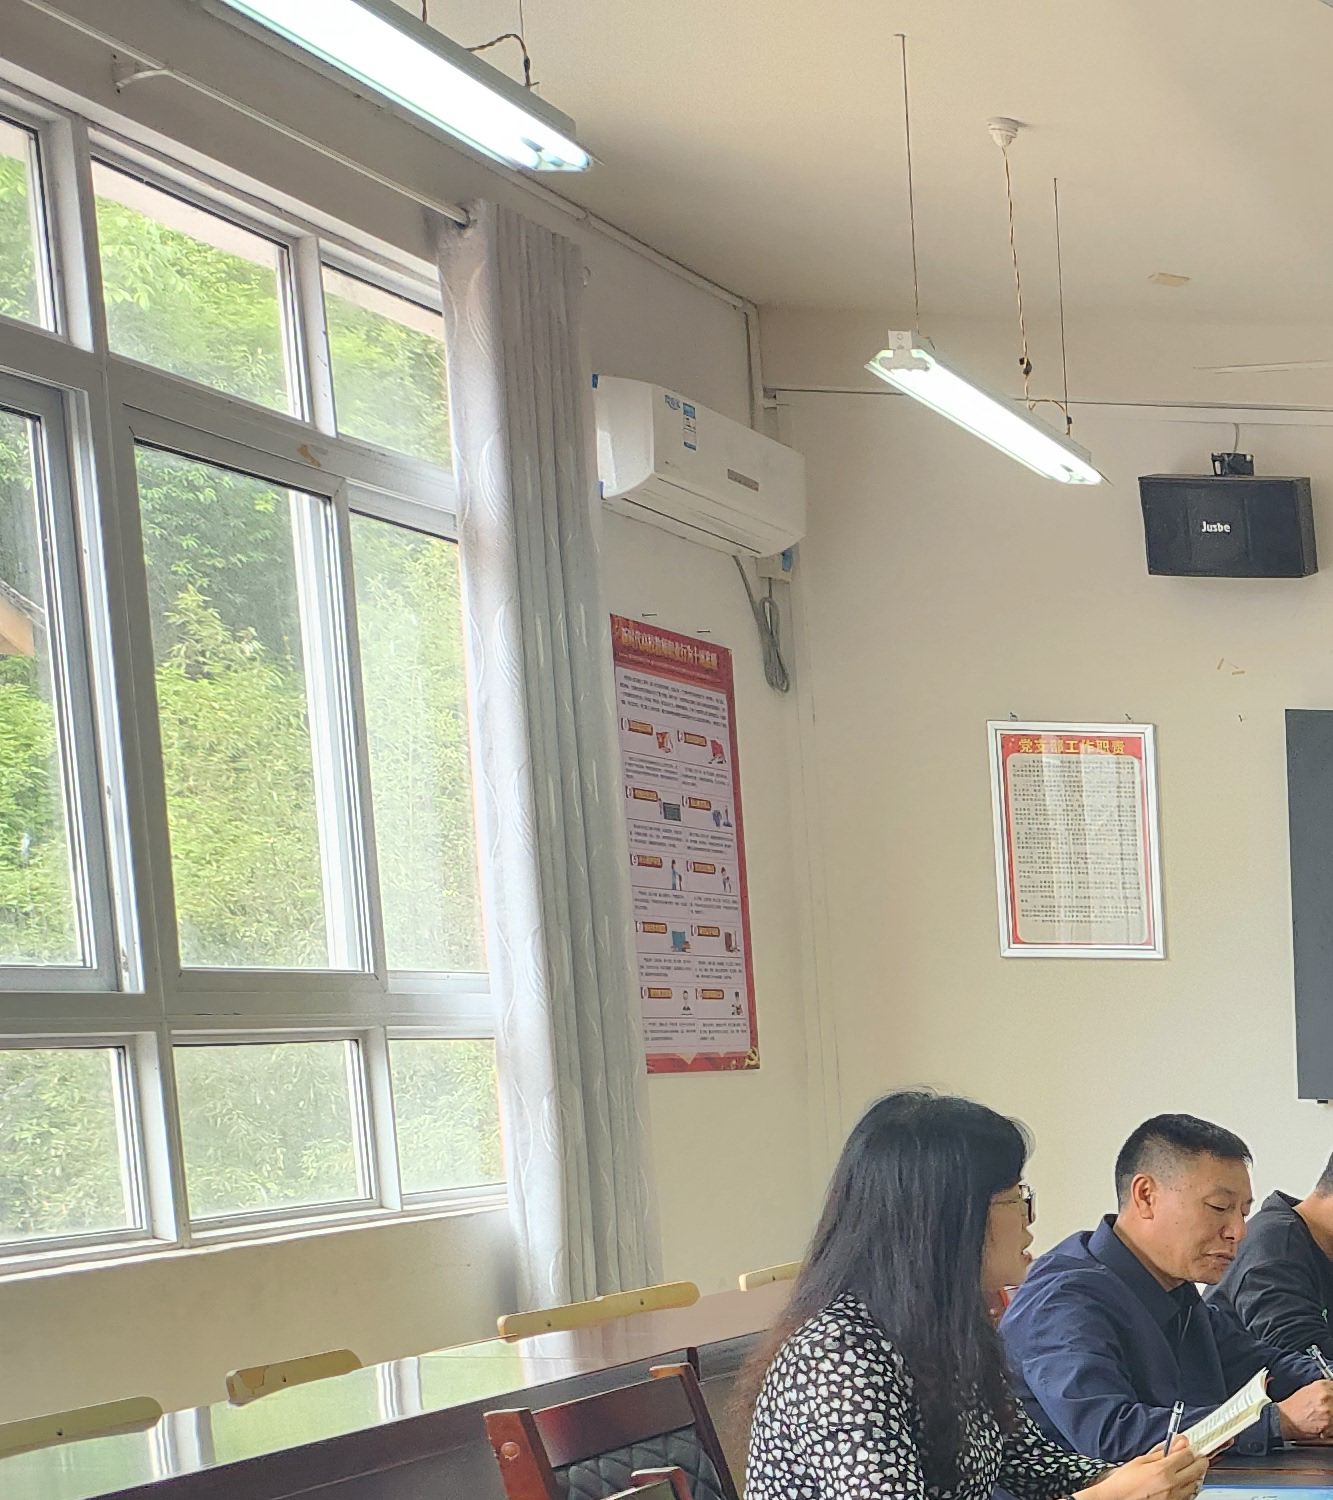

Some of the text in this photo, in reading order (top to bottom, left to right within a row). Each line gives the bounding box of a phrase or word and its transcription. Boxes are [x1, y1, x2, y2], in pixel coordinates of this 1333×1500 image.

[1201, 521, 1231, 533] Jusbe
[1018, 739, 1126, 755] 党支部工作职责
